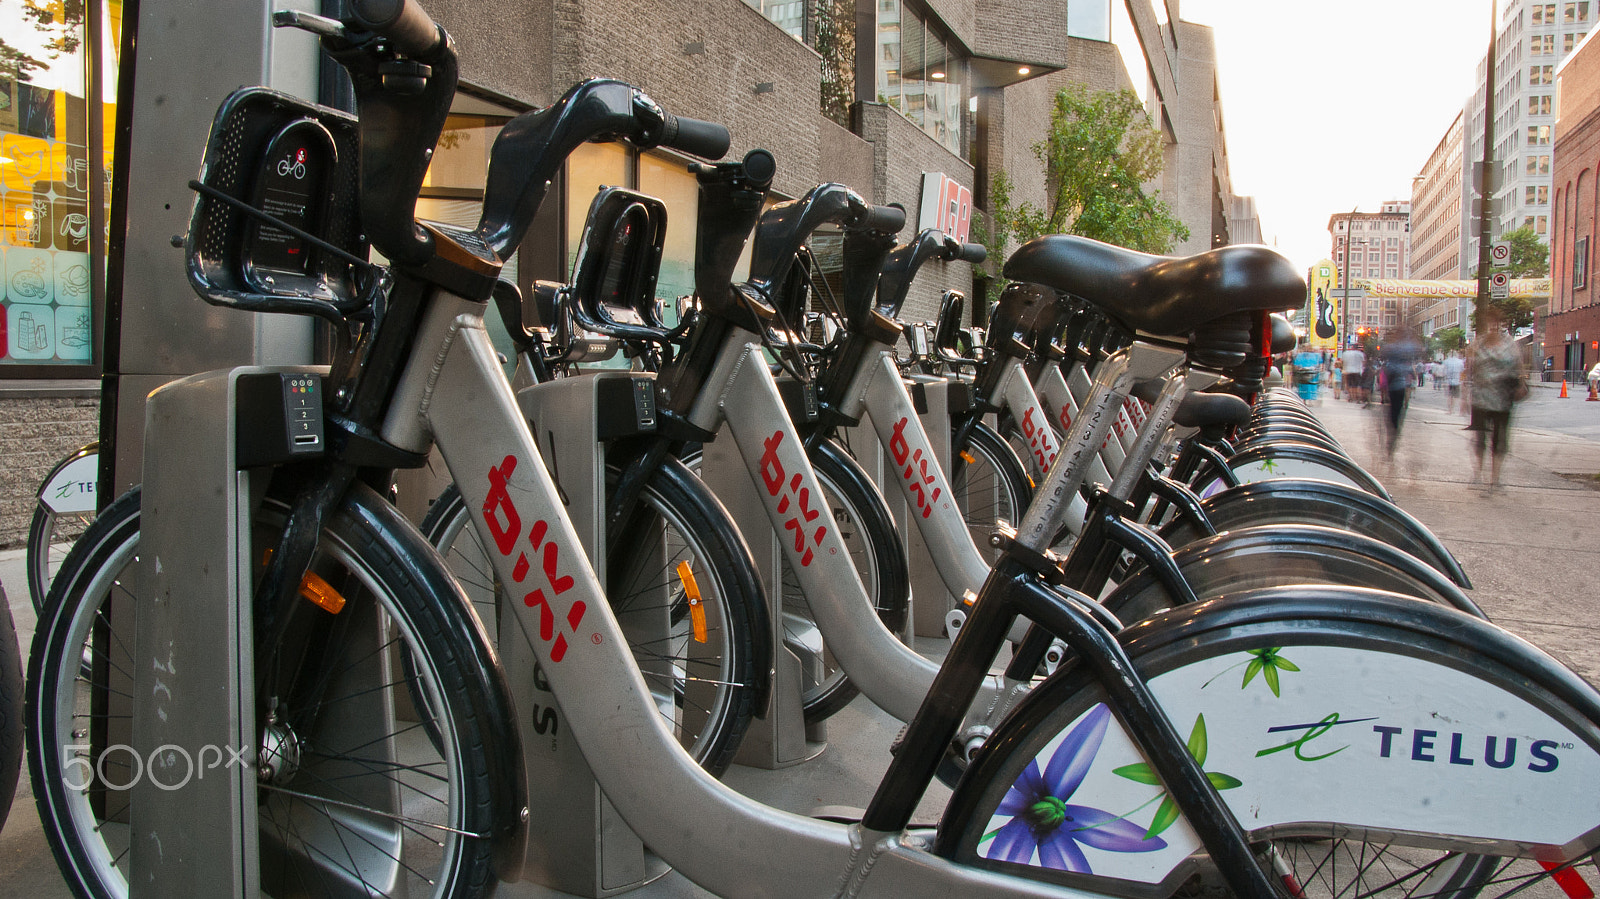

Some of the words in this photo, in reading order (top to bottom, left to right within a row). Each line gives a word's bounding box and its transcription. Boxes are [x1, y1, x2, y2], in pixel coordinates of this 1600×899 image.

[1376, 283, 1448, 294] Bienvenue
[1452, 286, 1469, 294] au
[1373, 725, 1560, 773] TELUS
